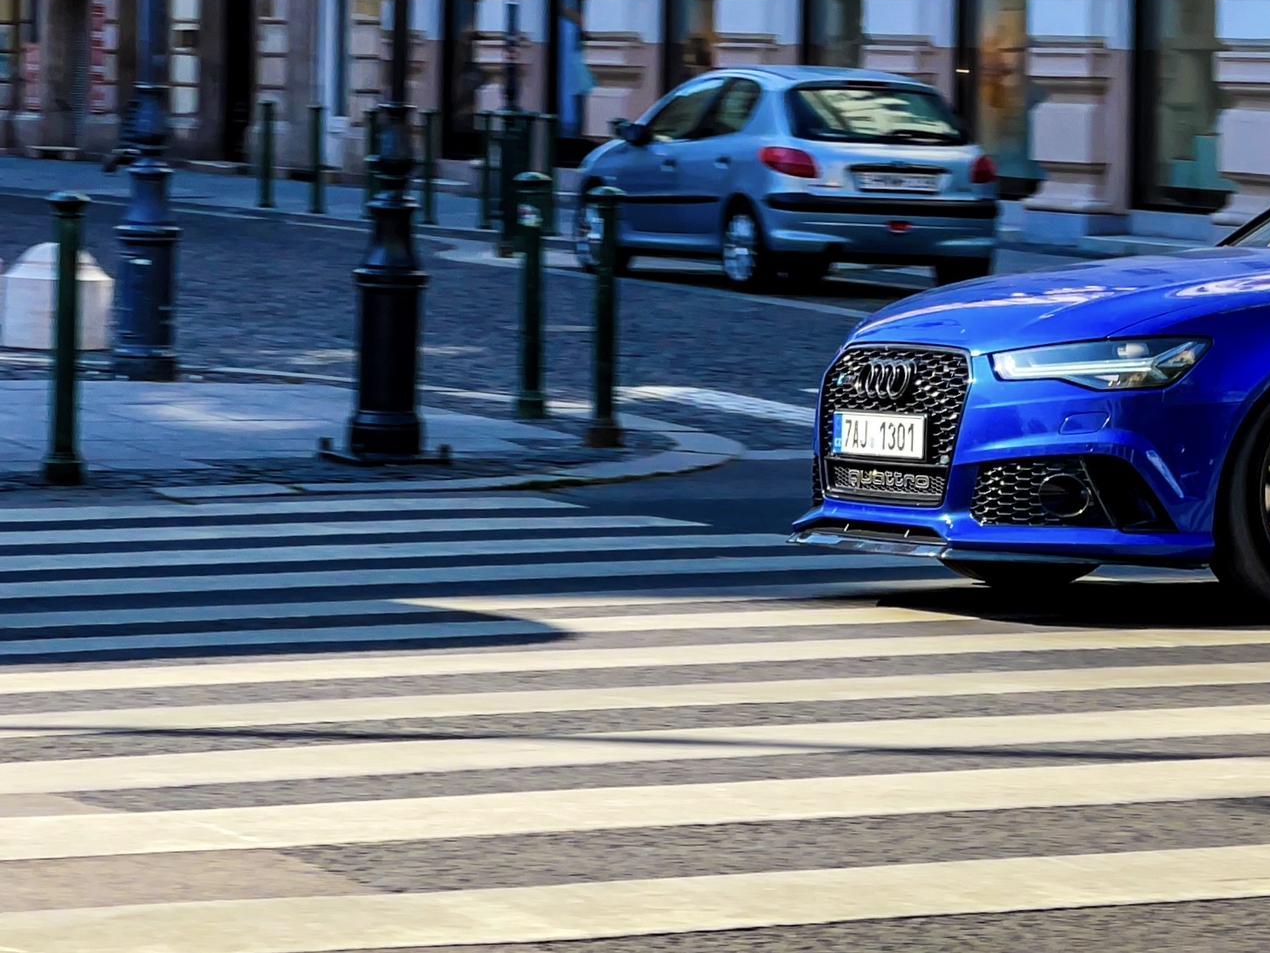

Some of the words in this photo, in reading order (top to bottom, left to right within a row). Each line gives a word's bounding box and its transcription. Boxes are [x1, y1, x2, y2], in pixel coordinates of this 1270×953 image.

[844, 419, 869, 449] 7AJ
[879, 421, 915, 453] 1301
[848, 468, 930, 489] quattro
